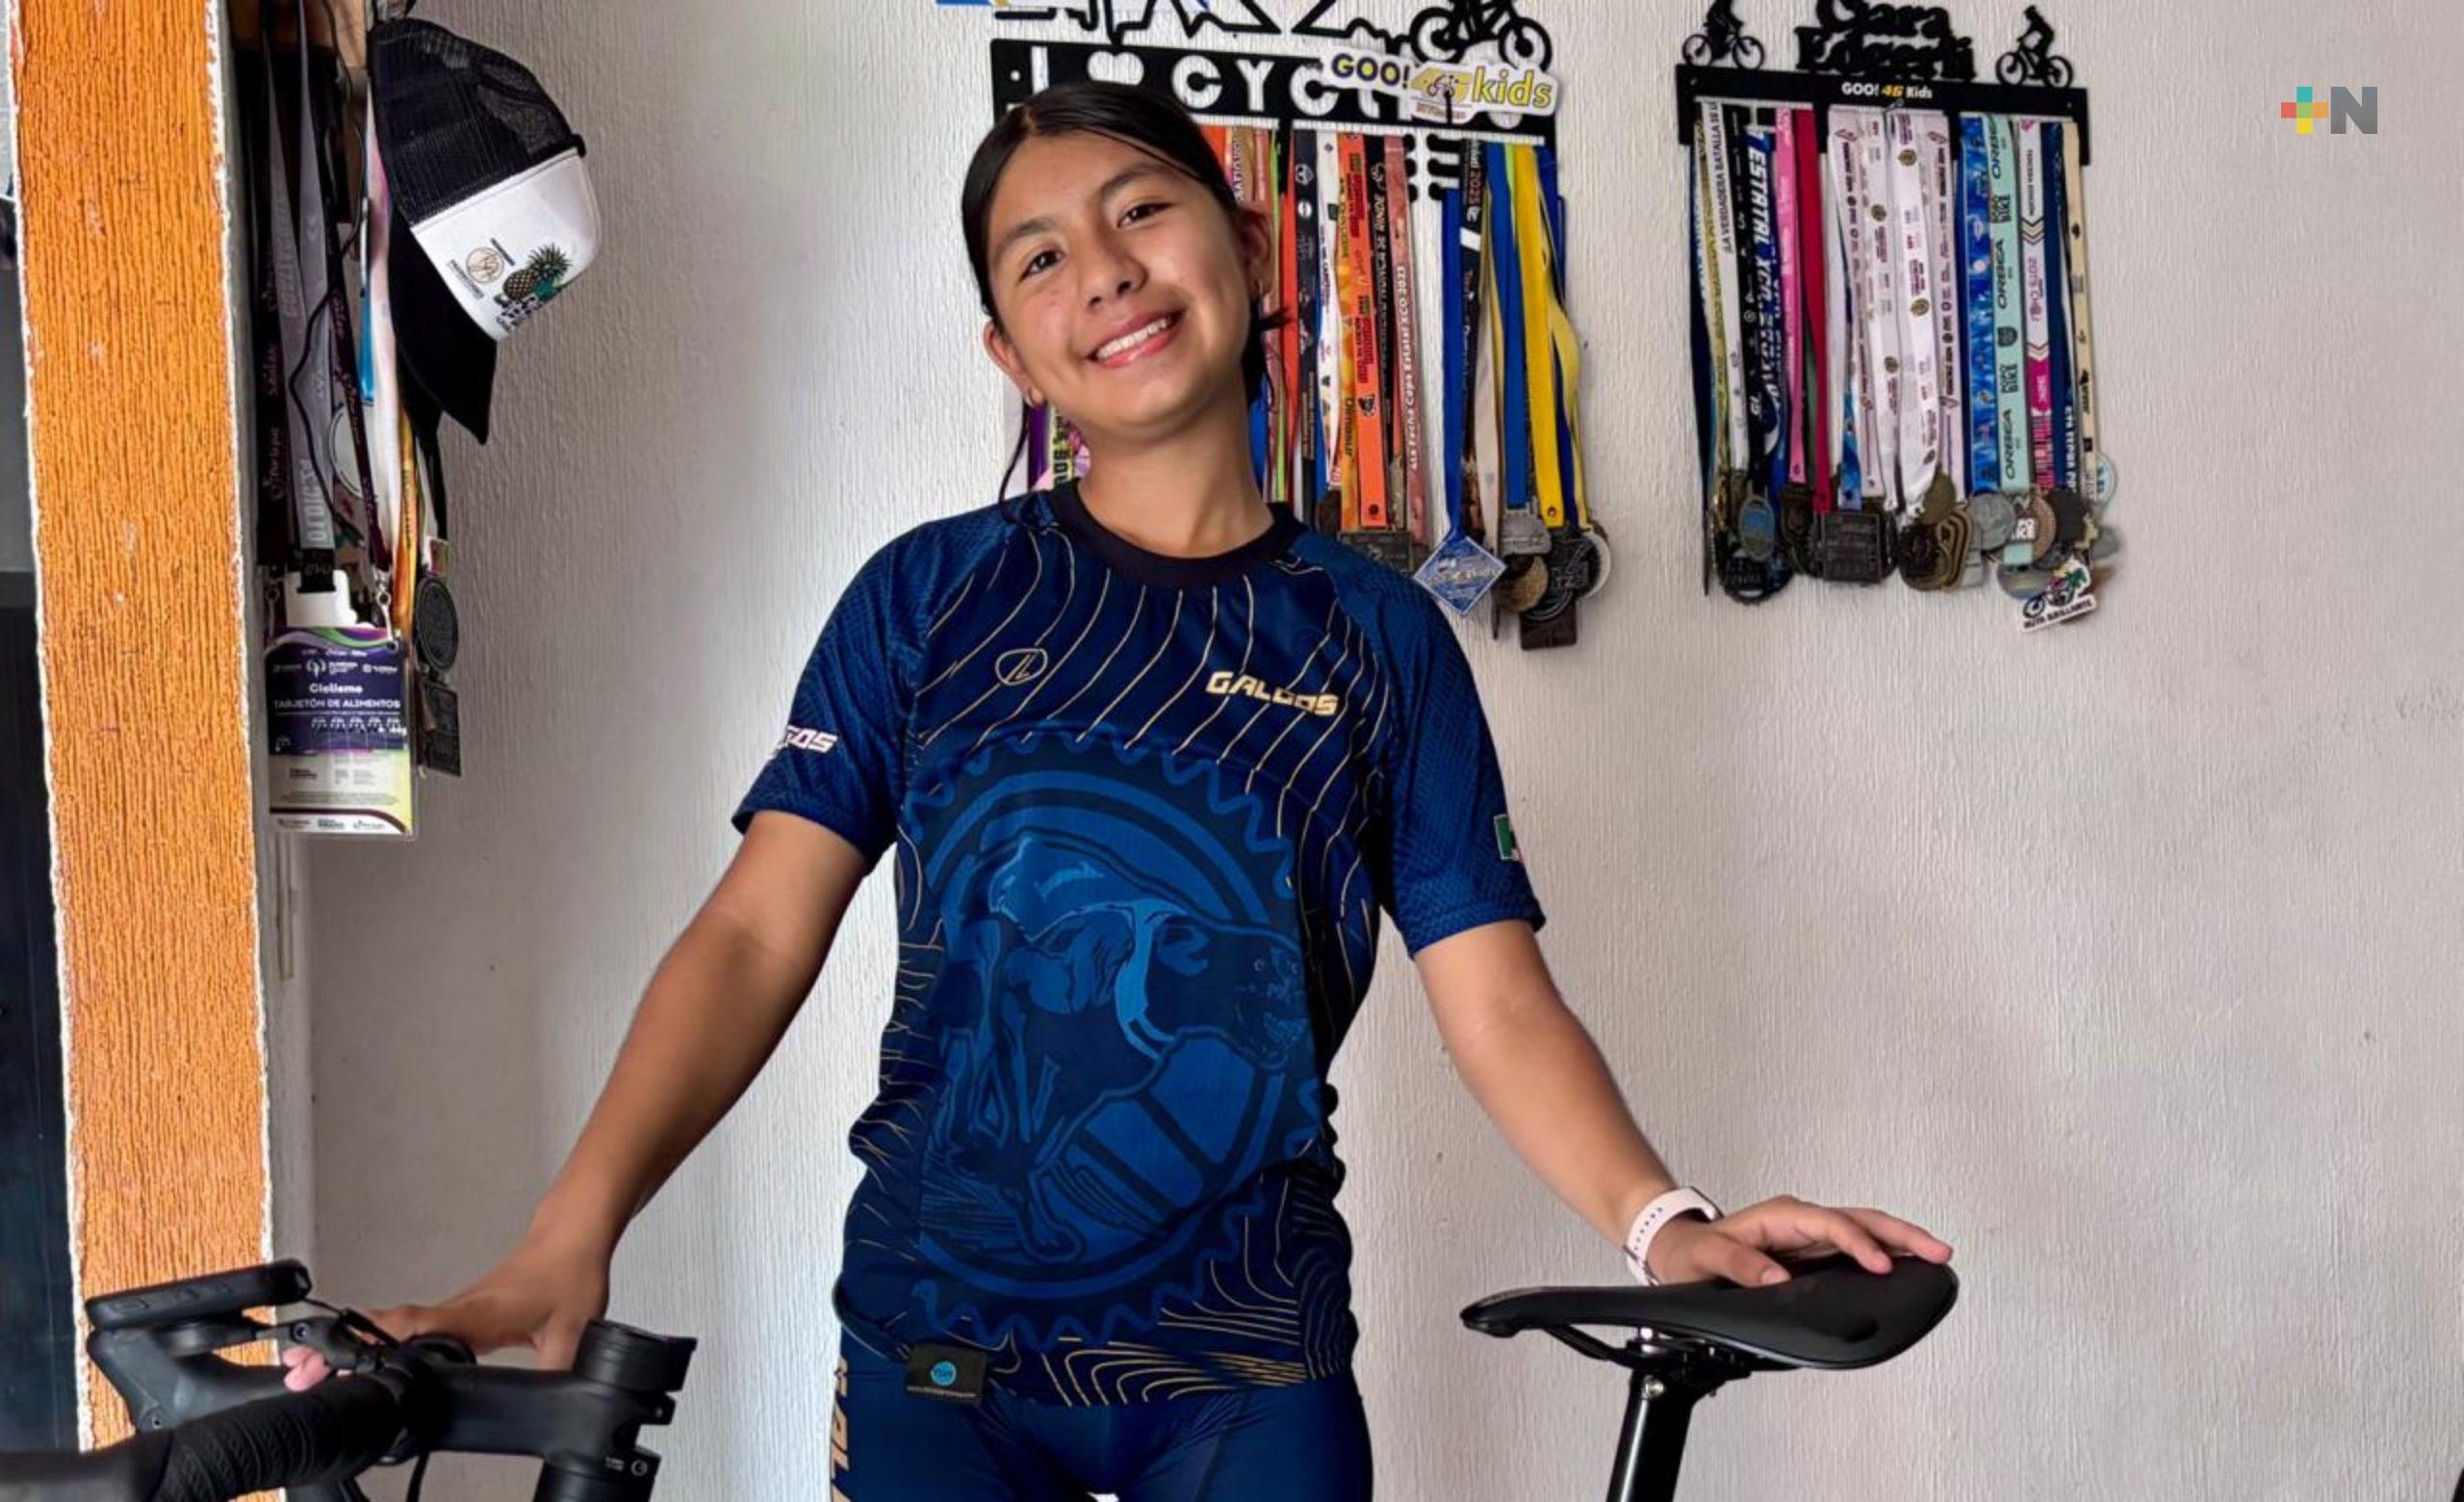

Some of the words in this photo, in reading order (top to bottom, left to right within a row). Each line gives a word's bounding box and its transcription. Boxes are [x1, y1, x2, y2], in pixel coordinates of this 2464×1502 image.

[1331, 52, 1410, 91] GOO!
[1471, 65, 1553, 109] kids
[1841, 81, 1880, 97] GOO!
[1906, 86, 1933, 99] Kids
[1710, 125, 1724, 170] BATALLA
[1715, 173, 1731, 235] VERDADERA
[1747, 146, 1770, 245] ESTATAL
[1400, 326, 1412, 371] Estatal
[1402, 374, 1416, 405] Copa
[309, 683, 363, 694] Ciclismo
[327, 699, 340, 709] DE
[343, 699, 400, 710] ALIMENTOS
[1206, 671, 1339, 716] GALGOS
